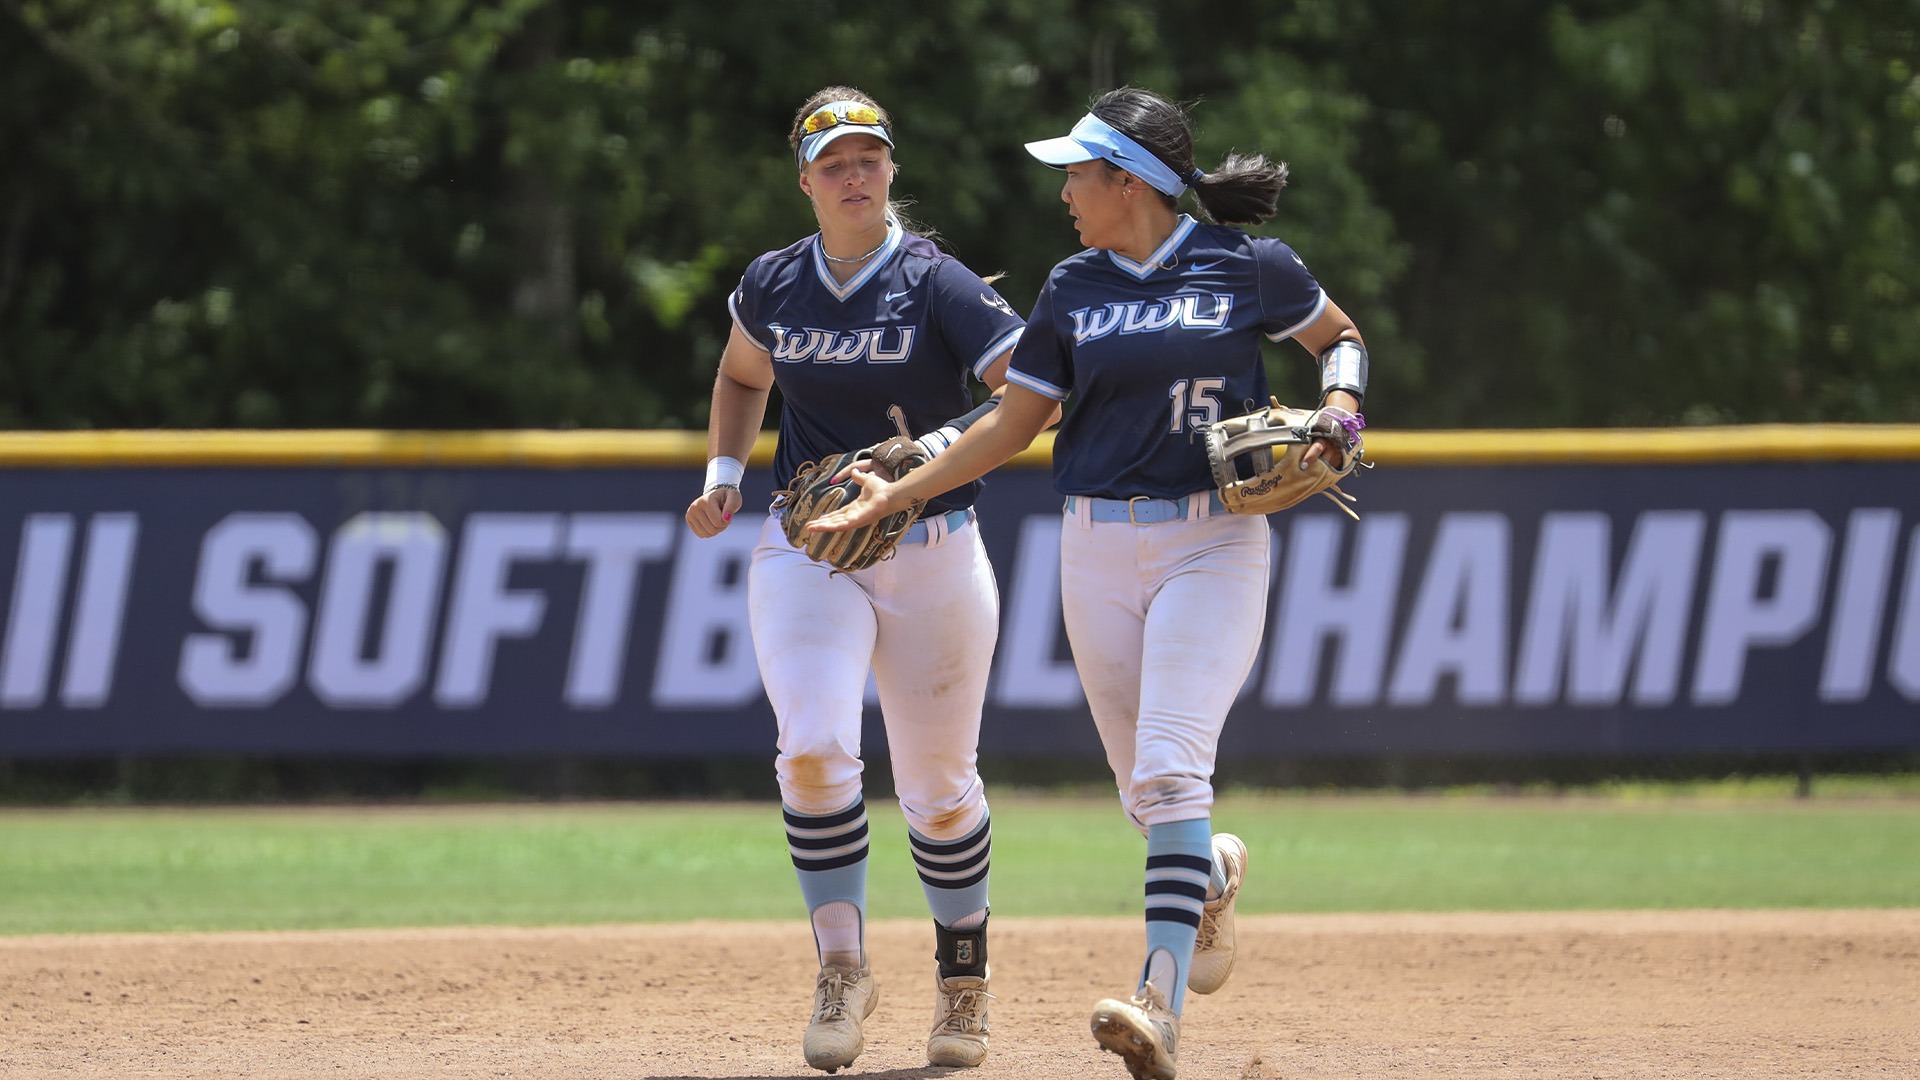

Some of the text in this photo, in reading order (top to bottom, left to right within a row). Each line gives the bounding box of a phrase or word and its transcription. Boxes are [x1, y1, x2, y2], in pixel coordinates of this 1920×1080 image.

[767, 322, 916, 364] WWU
[1068, 293, 1234, 347] WWU
[1169, 376, 1226, 434] 15
[1240, 474, 1283, 498] Rawlings
[178, 511, 1084, 708] SOFTBL
[1240, 508, 1920, 707] HAMPI
